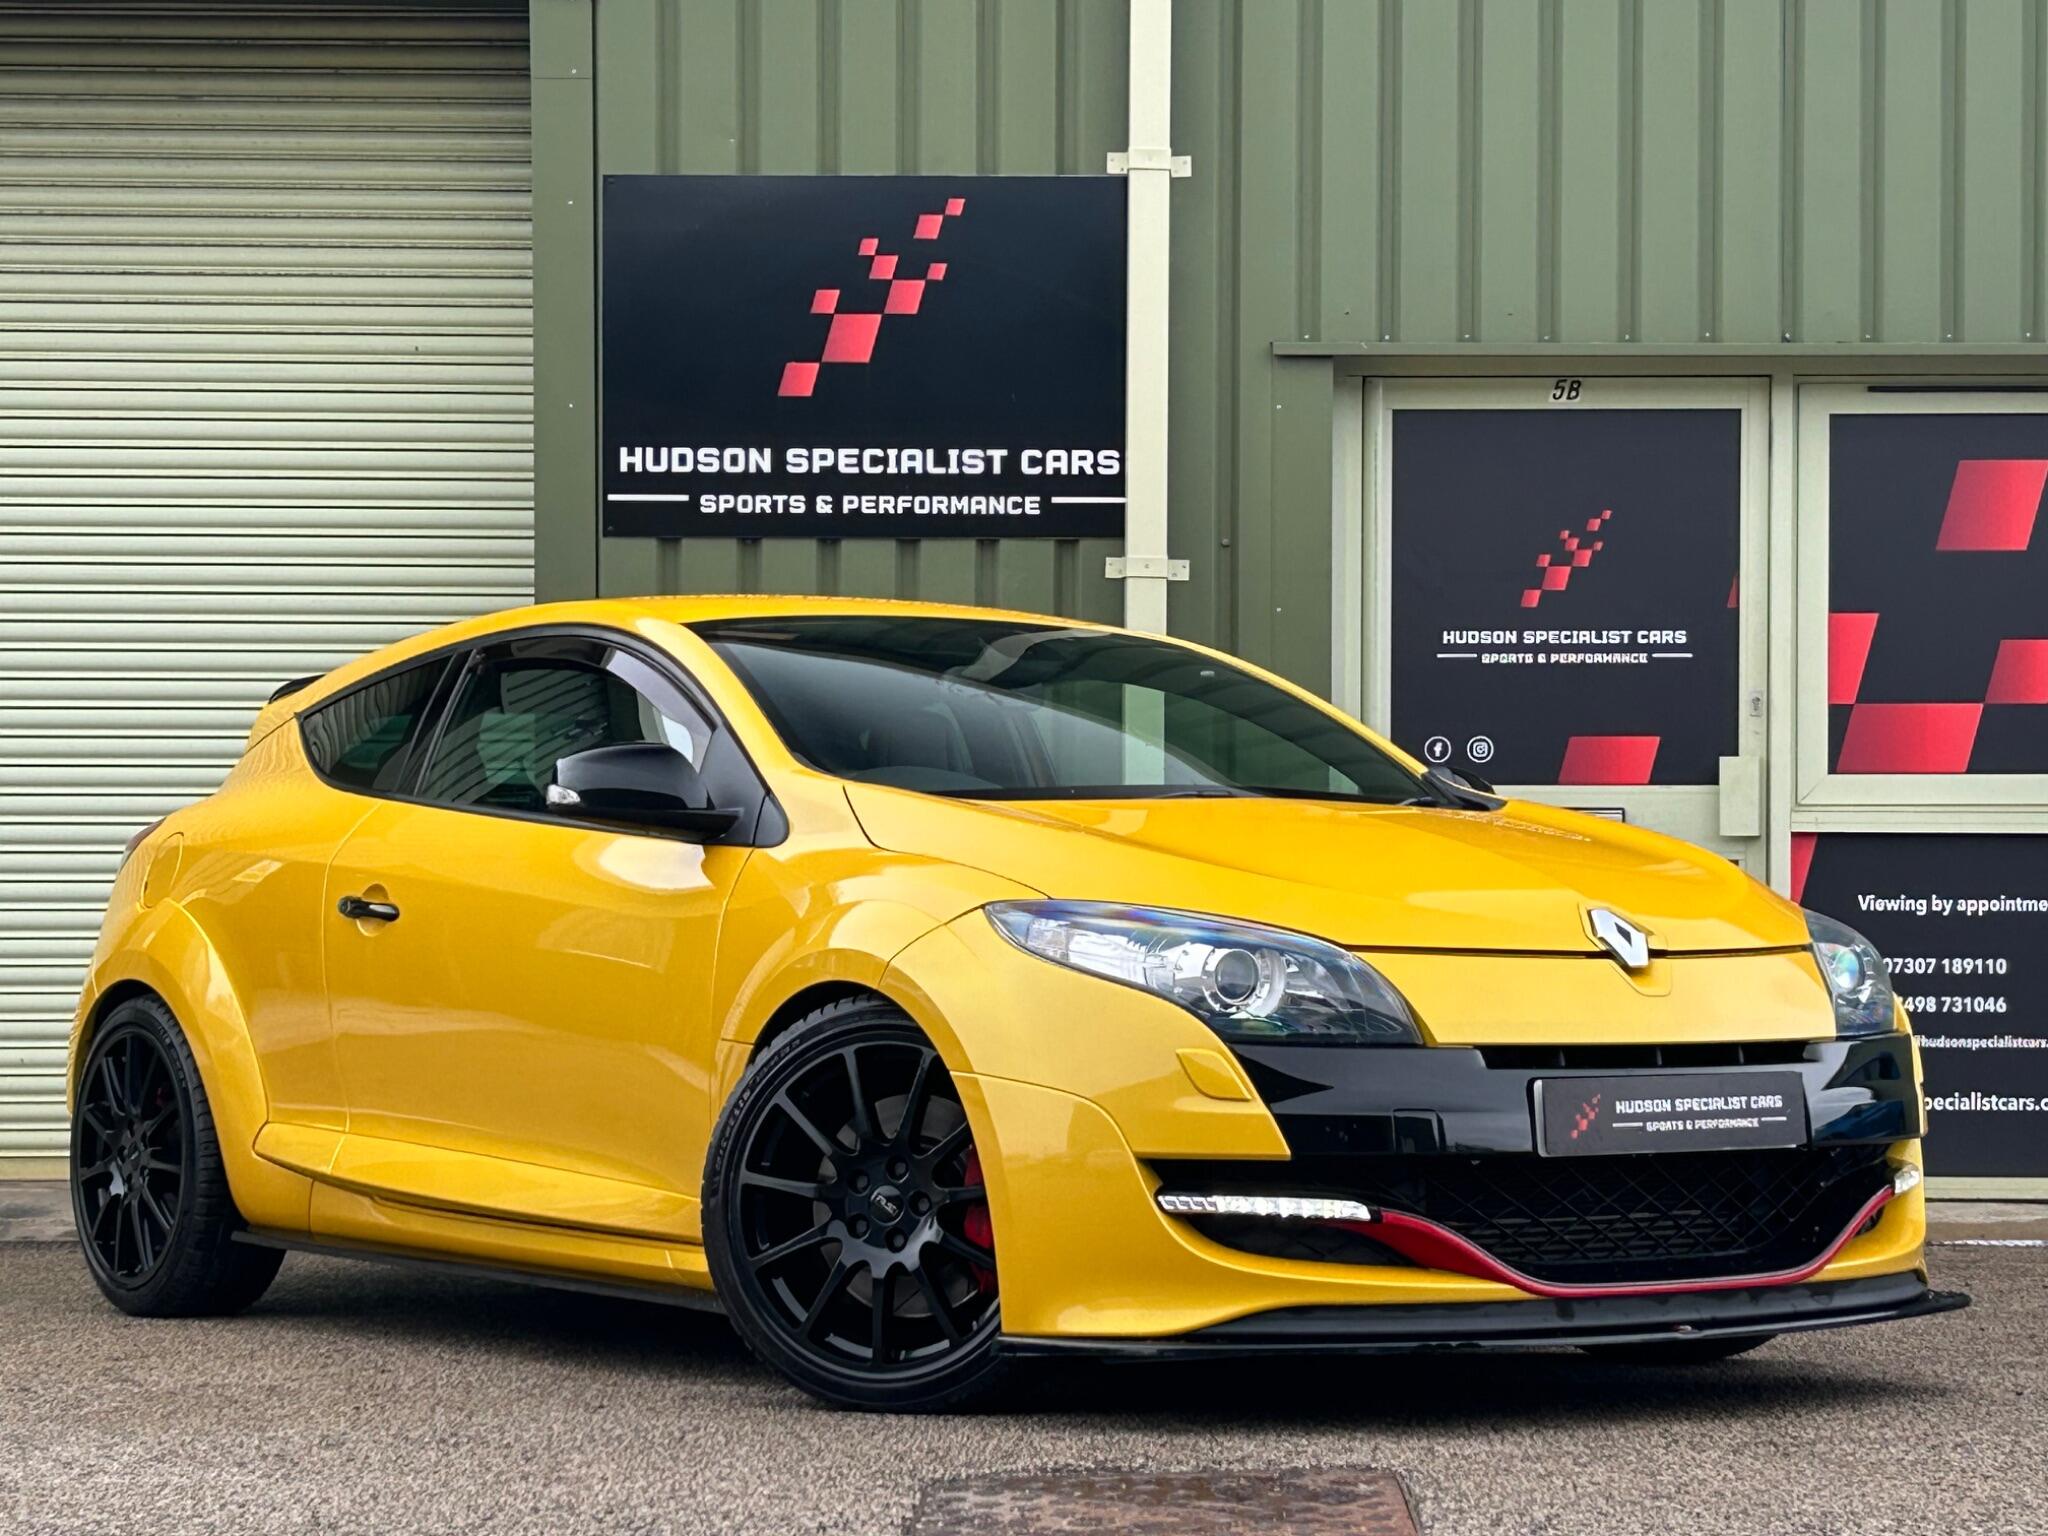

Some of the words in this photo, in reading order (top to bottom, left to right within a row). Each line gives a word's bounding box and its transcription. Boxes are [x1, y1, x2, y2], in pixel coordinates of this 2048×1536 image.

[1552, 379, 1582, 401] 5B
[619, 446, 772, 474] HUDSON
[785, 447, 1009, 475] SPECIALIST
[1020, 449, 1121, 475] CARS
[699, 494, 807, 514] SPORTS
[815, 494, 833, 514] &
[842, 494, 1041, 515] PERFORMANCE
[1442, 630, 1518, 645] HUDSON
[1522, 630, 1634, 645] SPECIALIST
[1636, 629, 1688, 644] CARS
[1481, 652, 1535, 665] SPORTS
[1549, 652, 1649, 665] PERFORMANCE
[1857, 894, 1928, 916] Viewing
[1931, 893, 1954, 917] by
[1956, 894, 2048, 917] appointme
[1941, 957, 2008, 975] 189110
[1898, 995, 1937, 1013] 498
[1940, 996, 2007, 1013] 731046
[1615, 1098, 1672, 1115] HUDSON
[1674, 1096, 1748, 1112] SPECIALIST
[1750, 1094, 1783, 1109] CARS
[1645, 1119, 1684, 1132] SPORTS
[1694, 1117, 1760, 1131] PERFORMANCE
